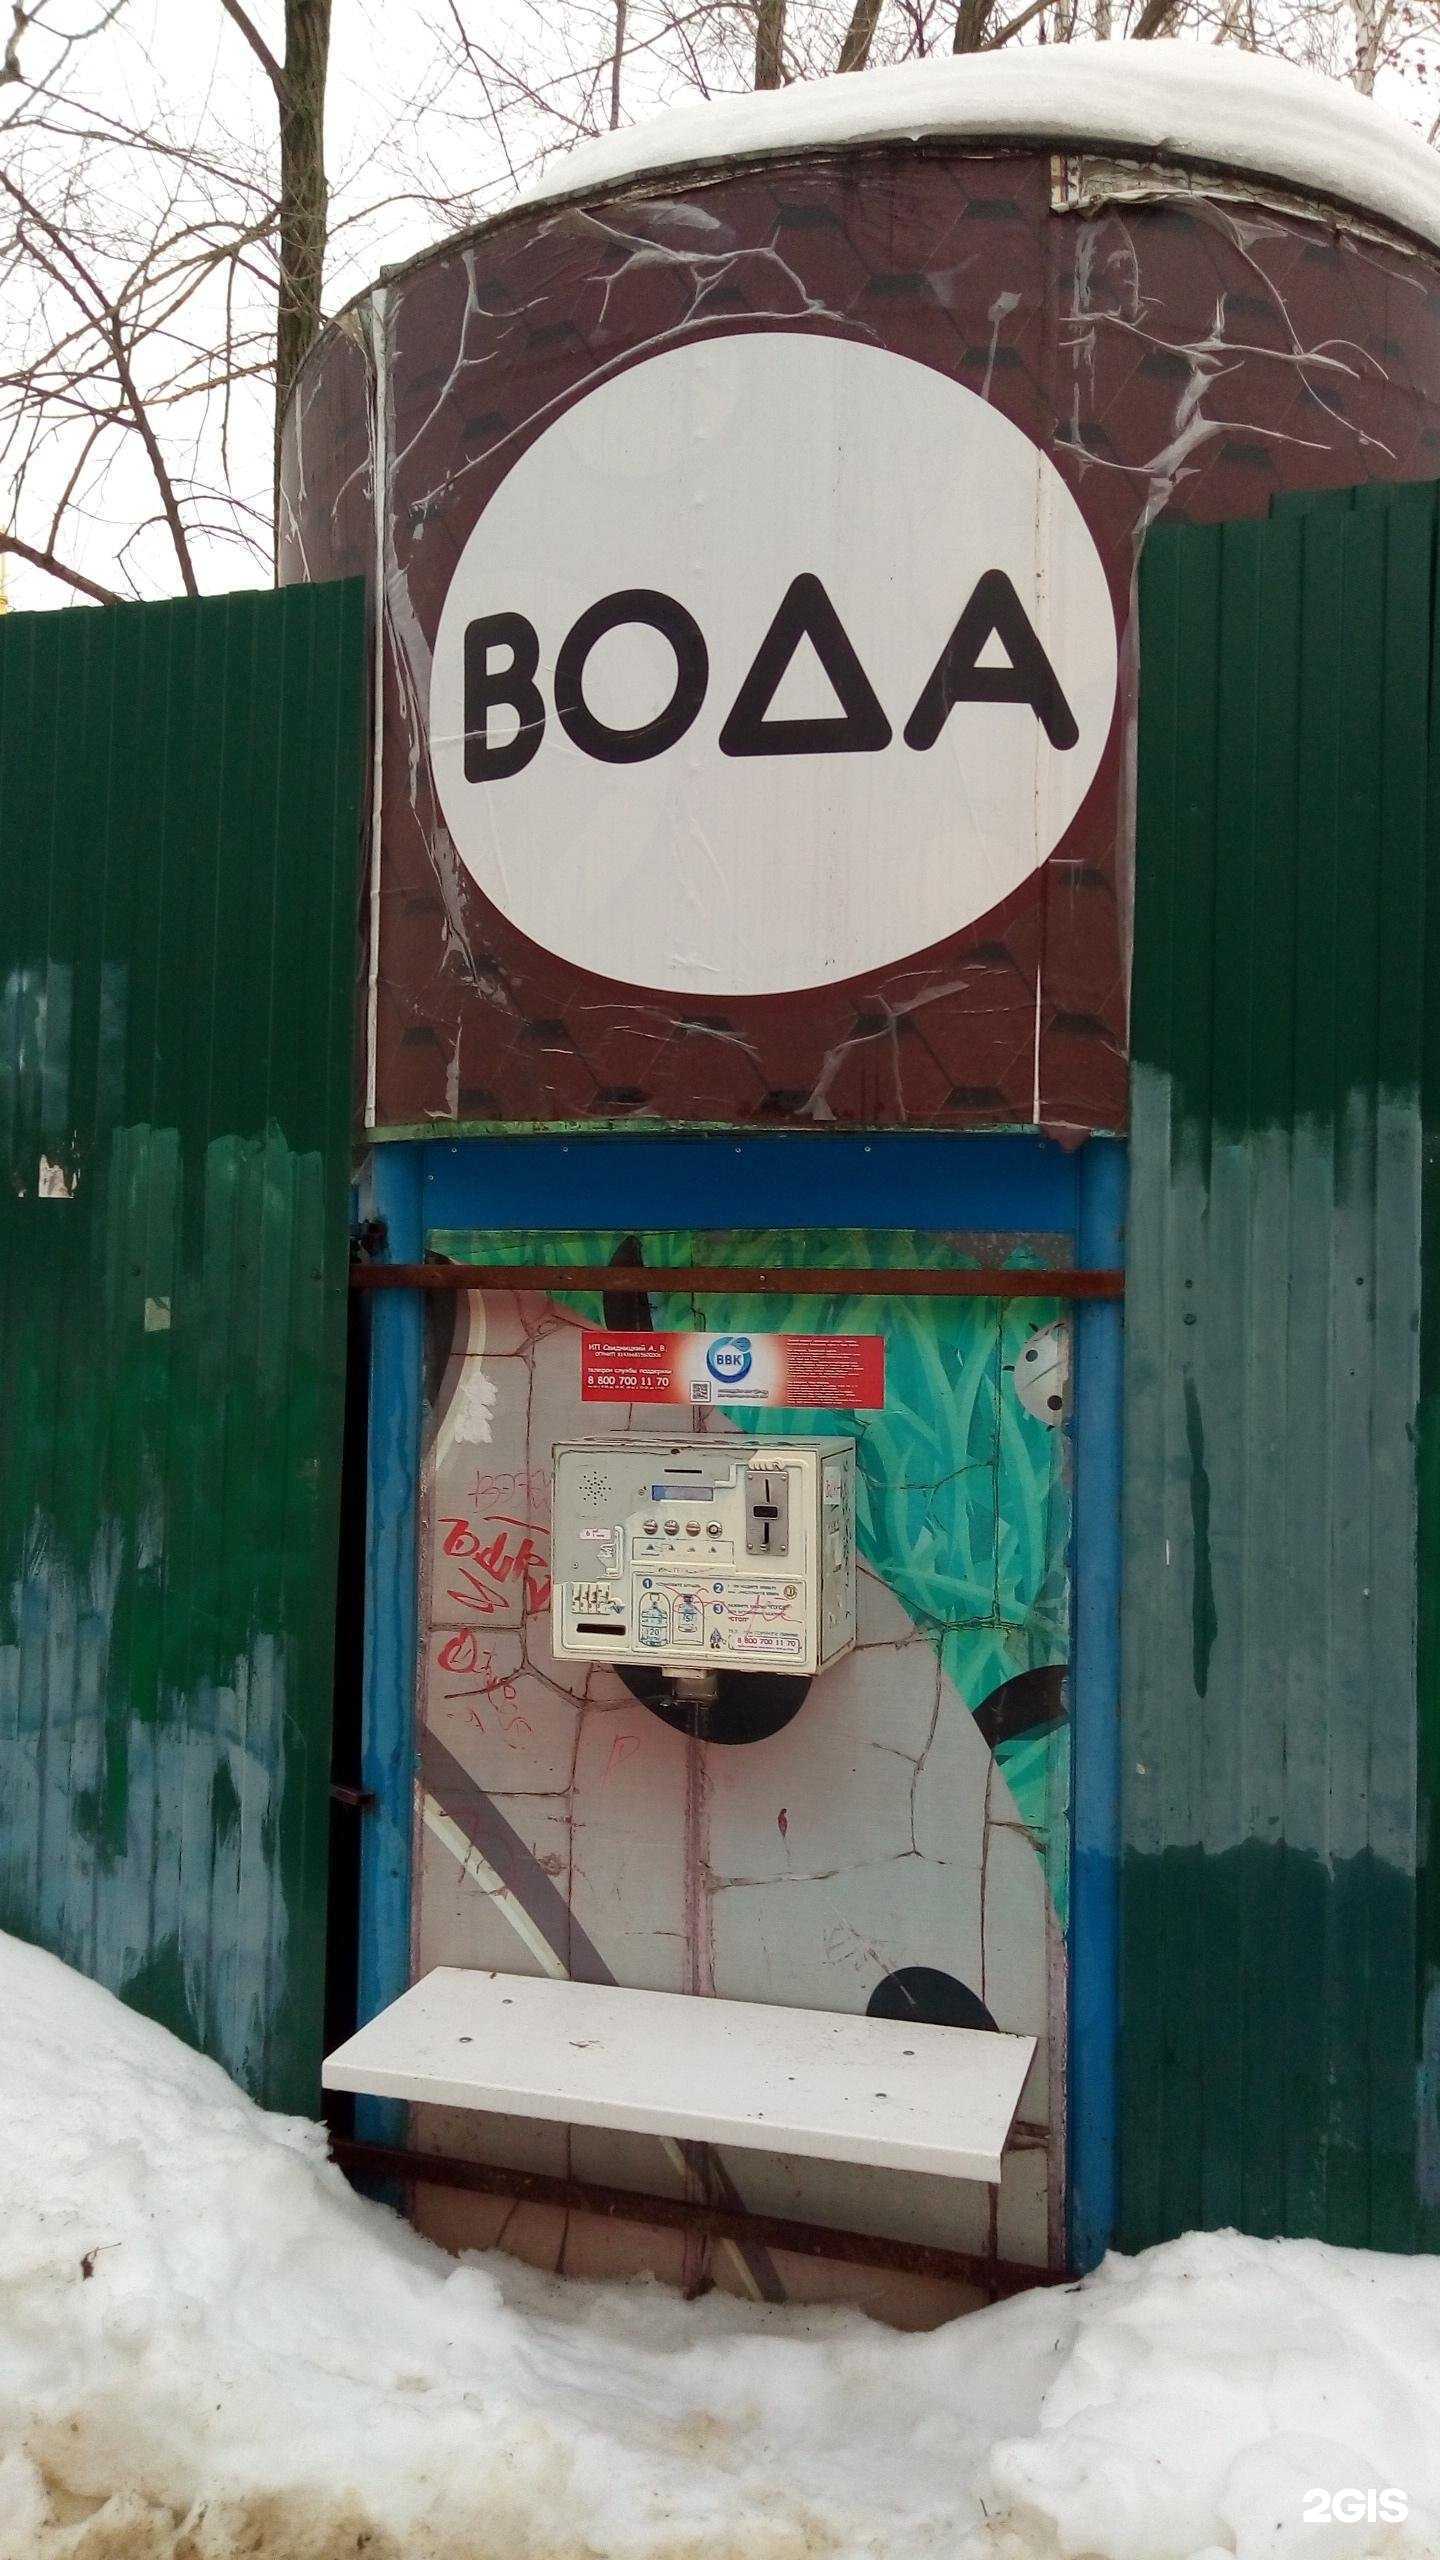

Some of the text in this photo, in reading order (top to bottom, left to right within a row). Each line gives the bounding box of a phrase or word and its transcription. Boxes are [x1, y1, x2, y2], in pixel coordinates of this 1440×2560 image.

[464, 569, 1080, 784] ВОДА
[588, 1343, 601, 1351] ИП
[587, 1375, 669, 1387] 8 800 700 11 70
[744, 1637, 758, 1645] 800
